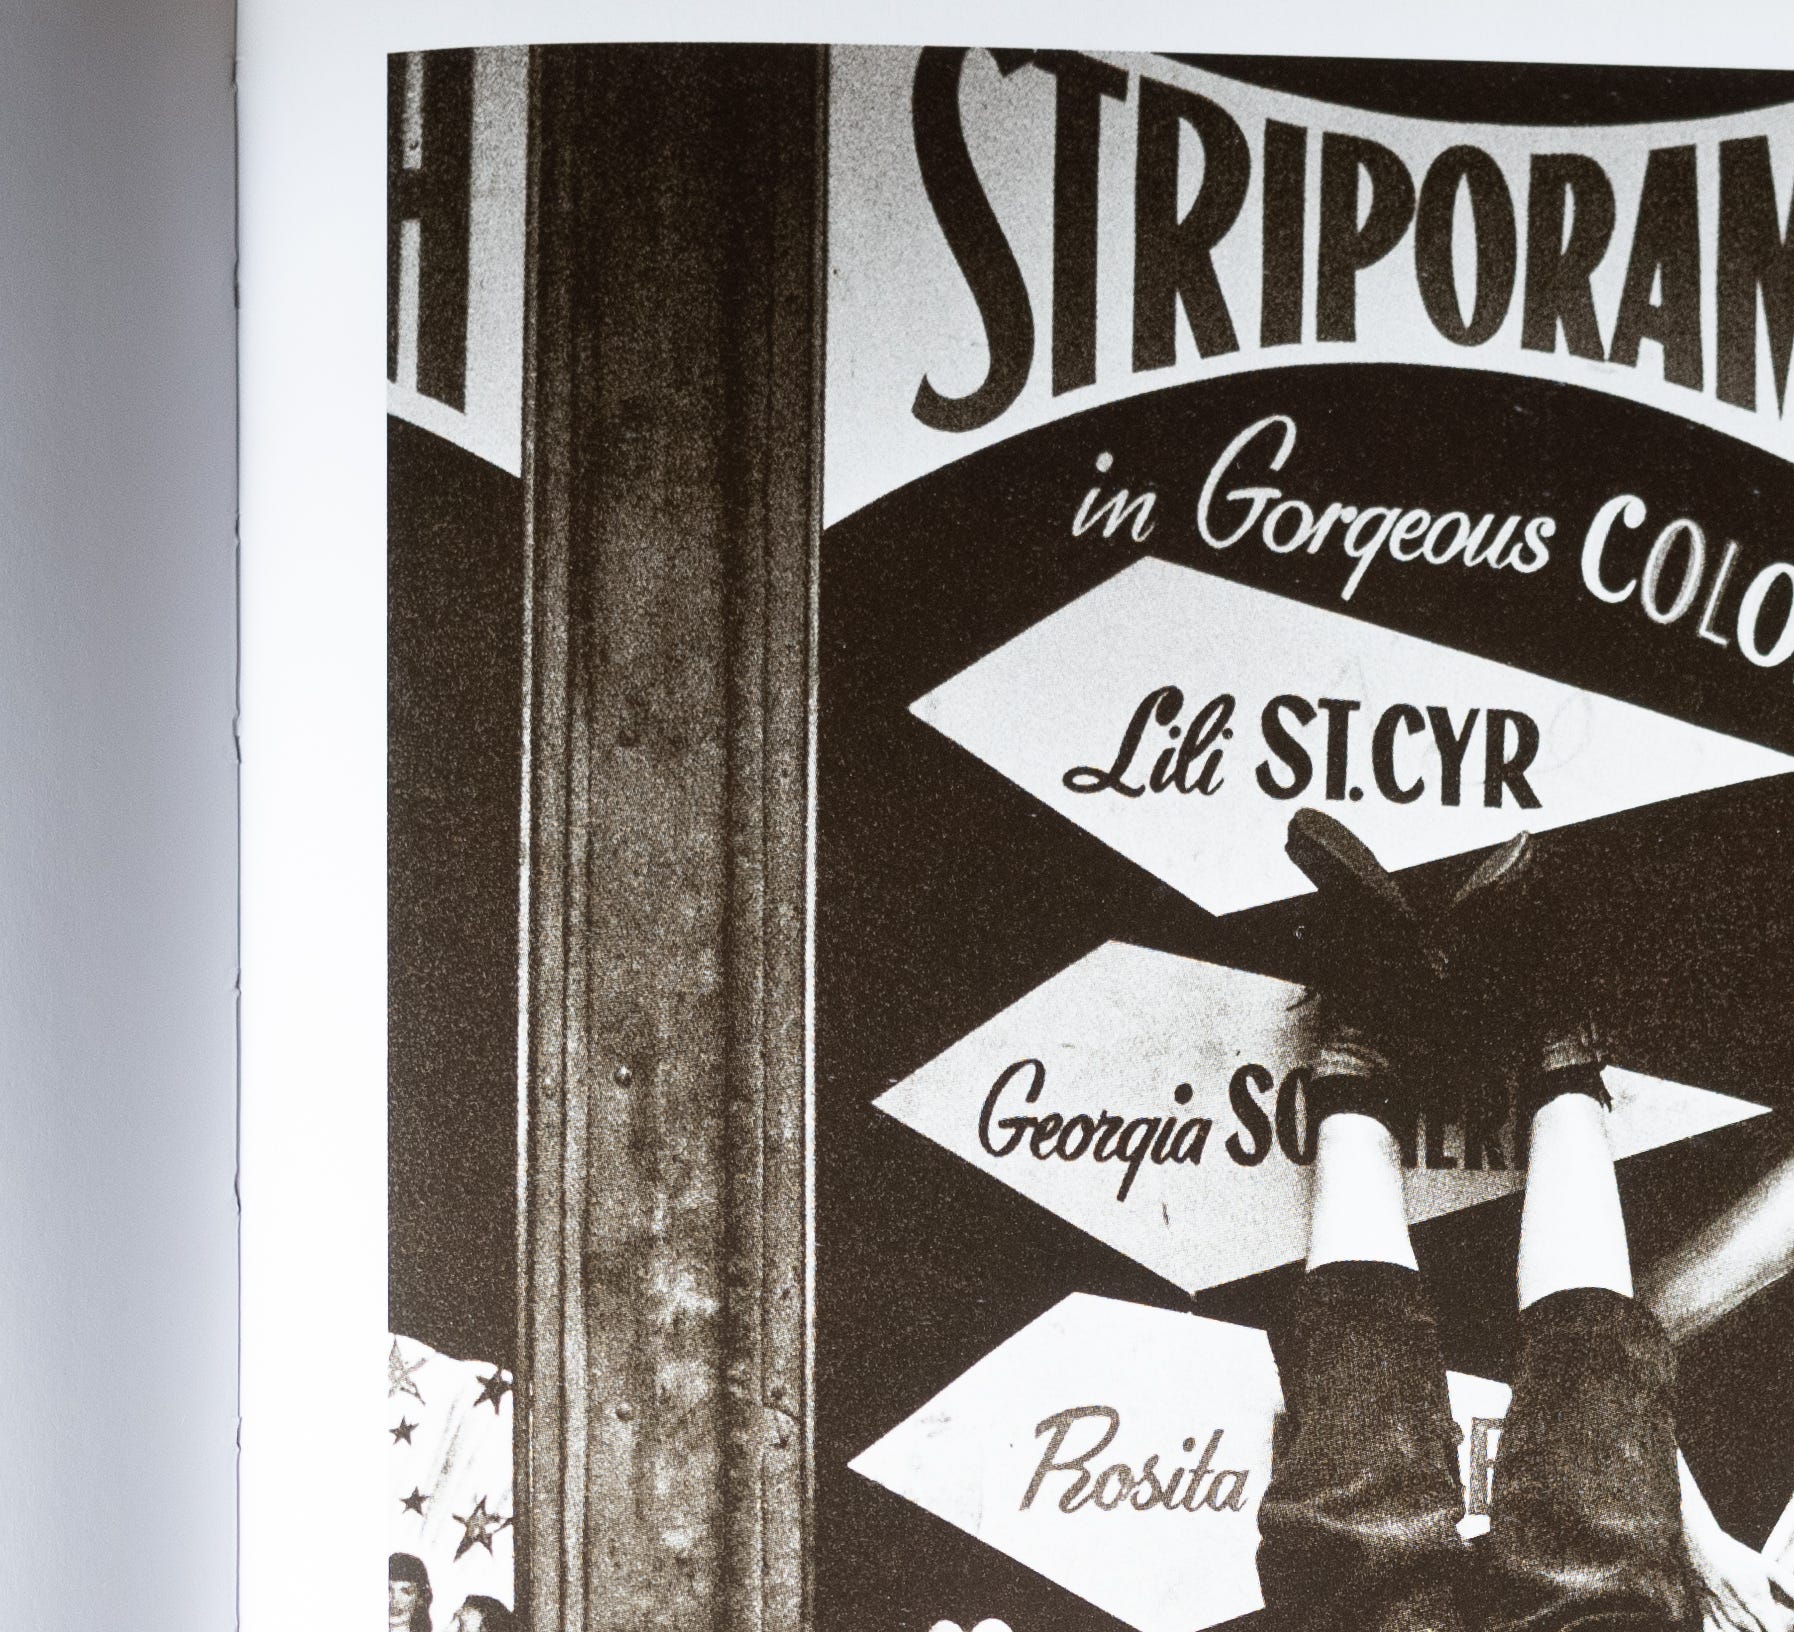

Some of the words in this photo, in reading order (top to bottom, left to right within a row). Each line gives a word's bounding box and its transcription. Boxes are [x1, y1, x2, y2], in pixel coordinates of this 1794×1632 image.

[1071, 452, 1157, 542] in
[1197, 414, 1558, 600] Gorgeous
[1061, 685, 1236, 799] Lili
[977, 1057, 1213, 1202] Georgia
[1018, 1404, 1252, 1516] Rosita
